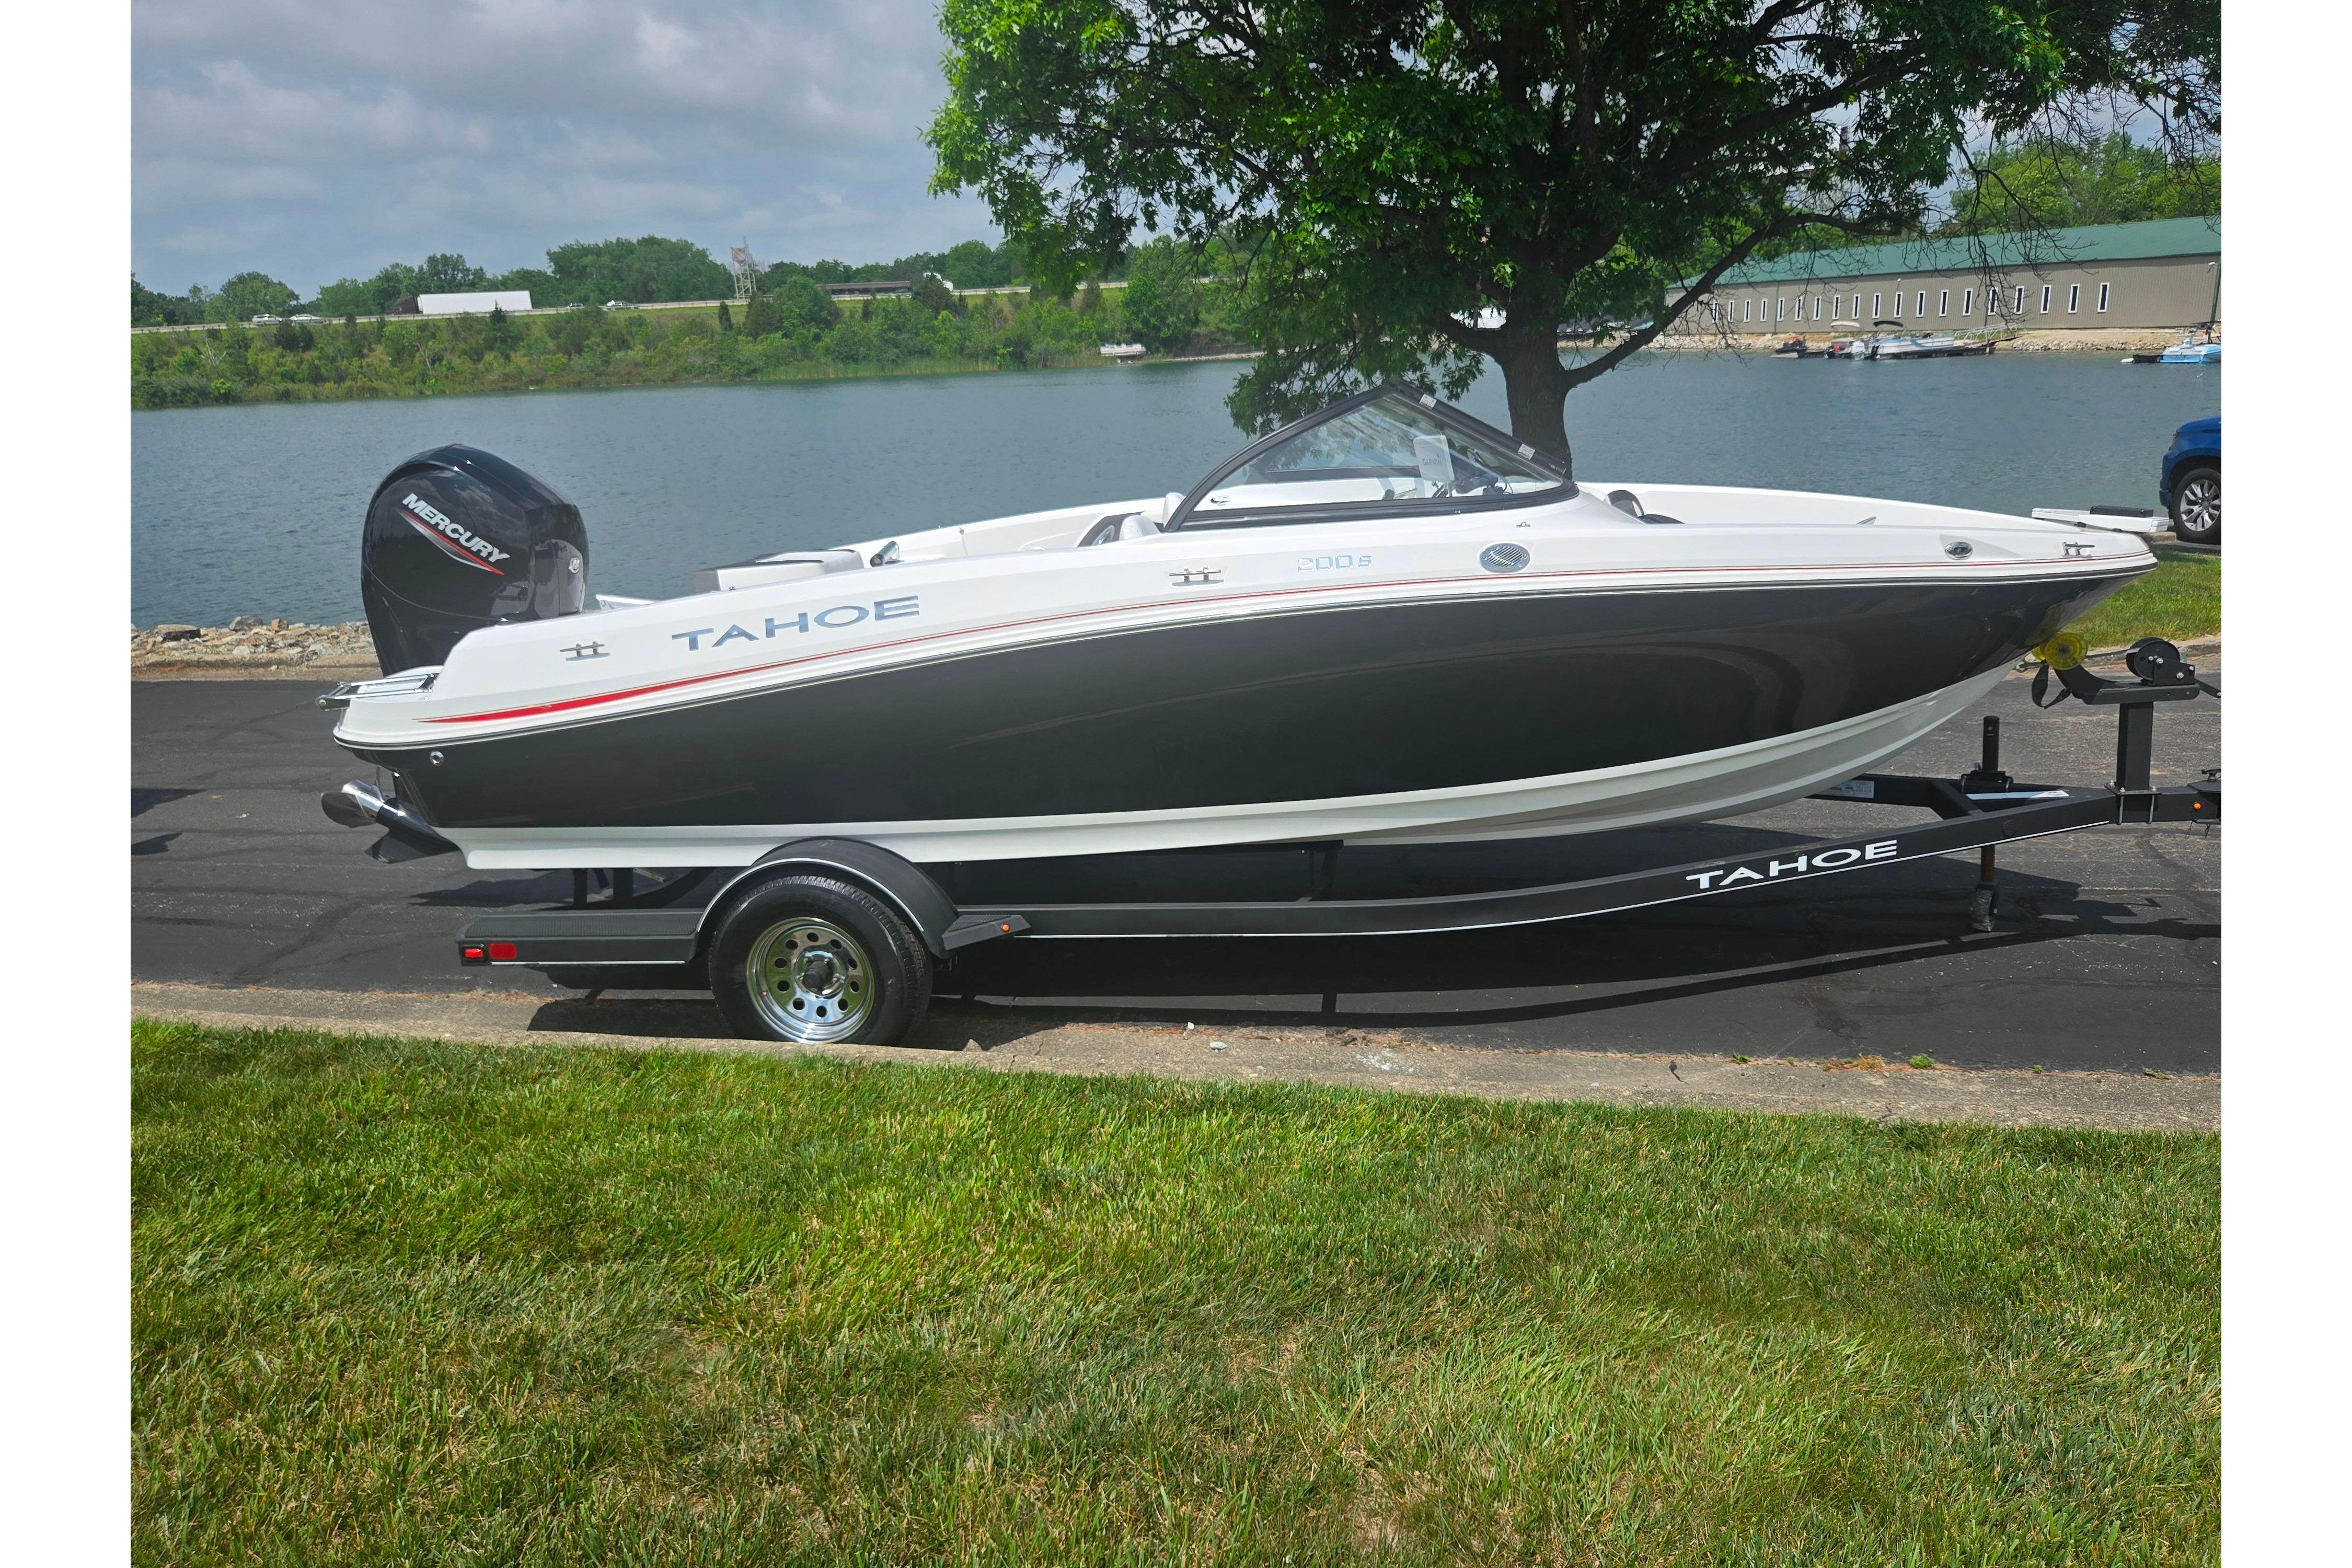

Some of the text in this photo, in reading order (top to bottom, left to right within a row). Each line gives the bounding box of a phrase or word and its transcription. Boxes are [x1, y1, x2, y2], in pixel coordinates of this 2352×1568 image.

[402, 493, 510, 563] MERCURY
[672, 595, 920, 651] TAHOE
[1686, 839, 1898, 889] TAHOE
